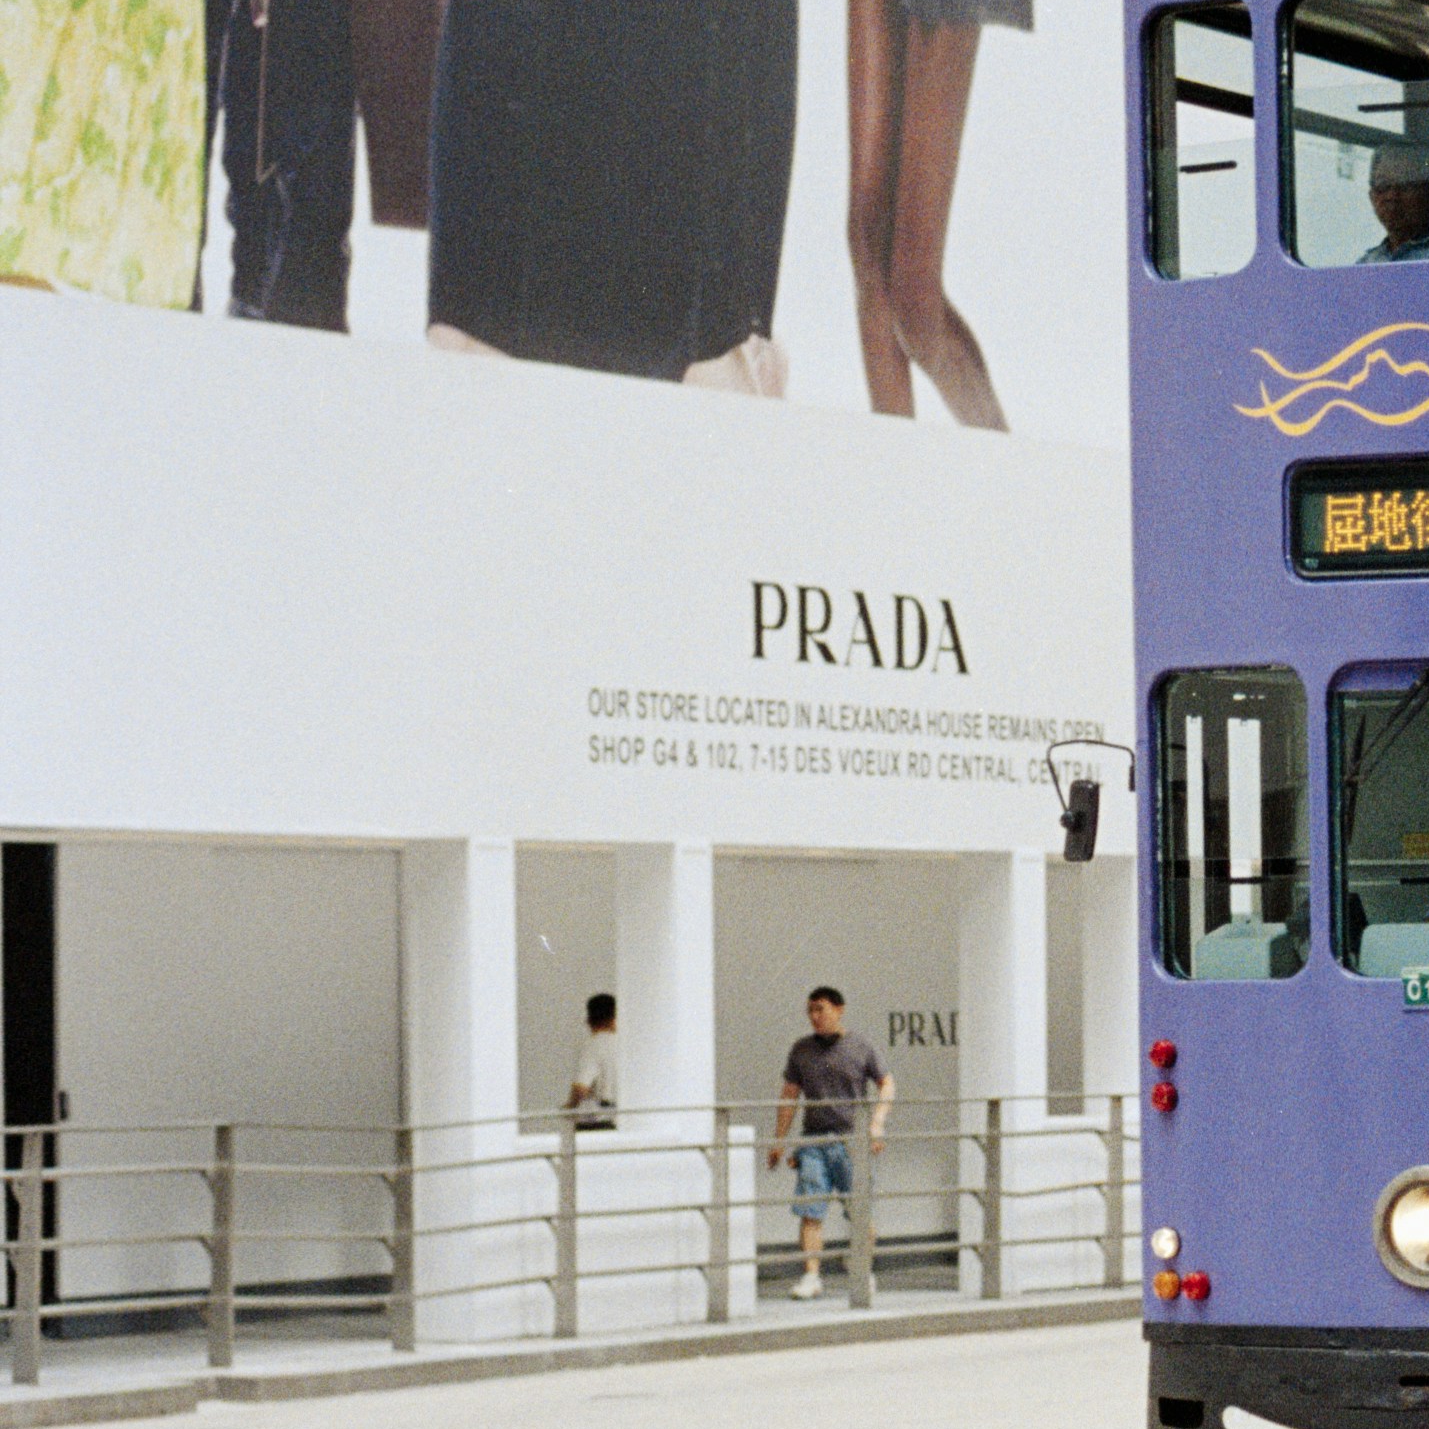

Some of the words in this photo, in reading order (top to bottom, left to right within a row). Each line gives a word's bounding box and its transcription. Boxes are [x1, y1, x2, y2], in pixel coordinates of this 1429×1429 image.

[751, 580, 971, 676] PRADA
[588, 687, 630, 718] OUR
[636, 690, 699, 722] STORE
[704, 695, 790, 728] LOCATED
[795, 702, 812, 729] IN
[817, 704, 922, 735] ALEXANDRA
[927, 710, 983, 741] HOUSE
[988, 712, 1057, 743] REMAINS
[1063, 719, 1105, 746] OPEN
[588, 734, 645, 765] SHOP
[653, 737, 678, 768] G4
[686, 739, 698, 768] &
[750, 743, 789, 773] 7-15
[795, 745, 832, 774] DES
[839, 747, 900, 777] VOEUX
[907, 751, 931, 779] RD
